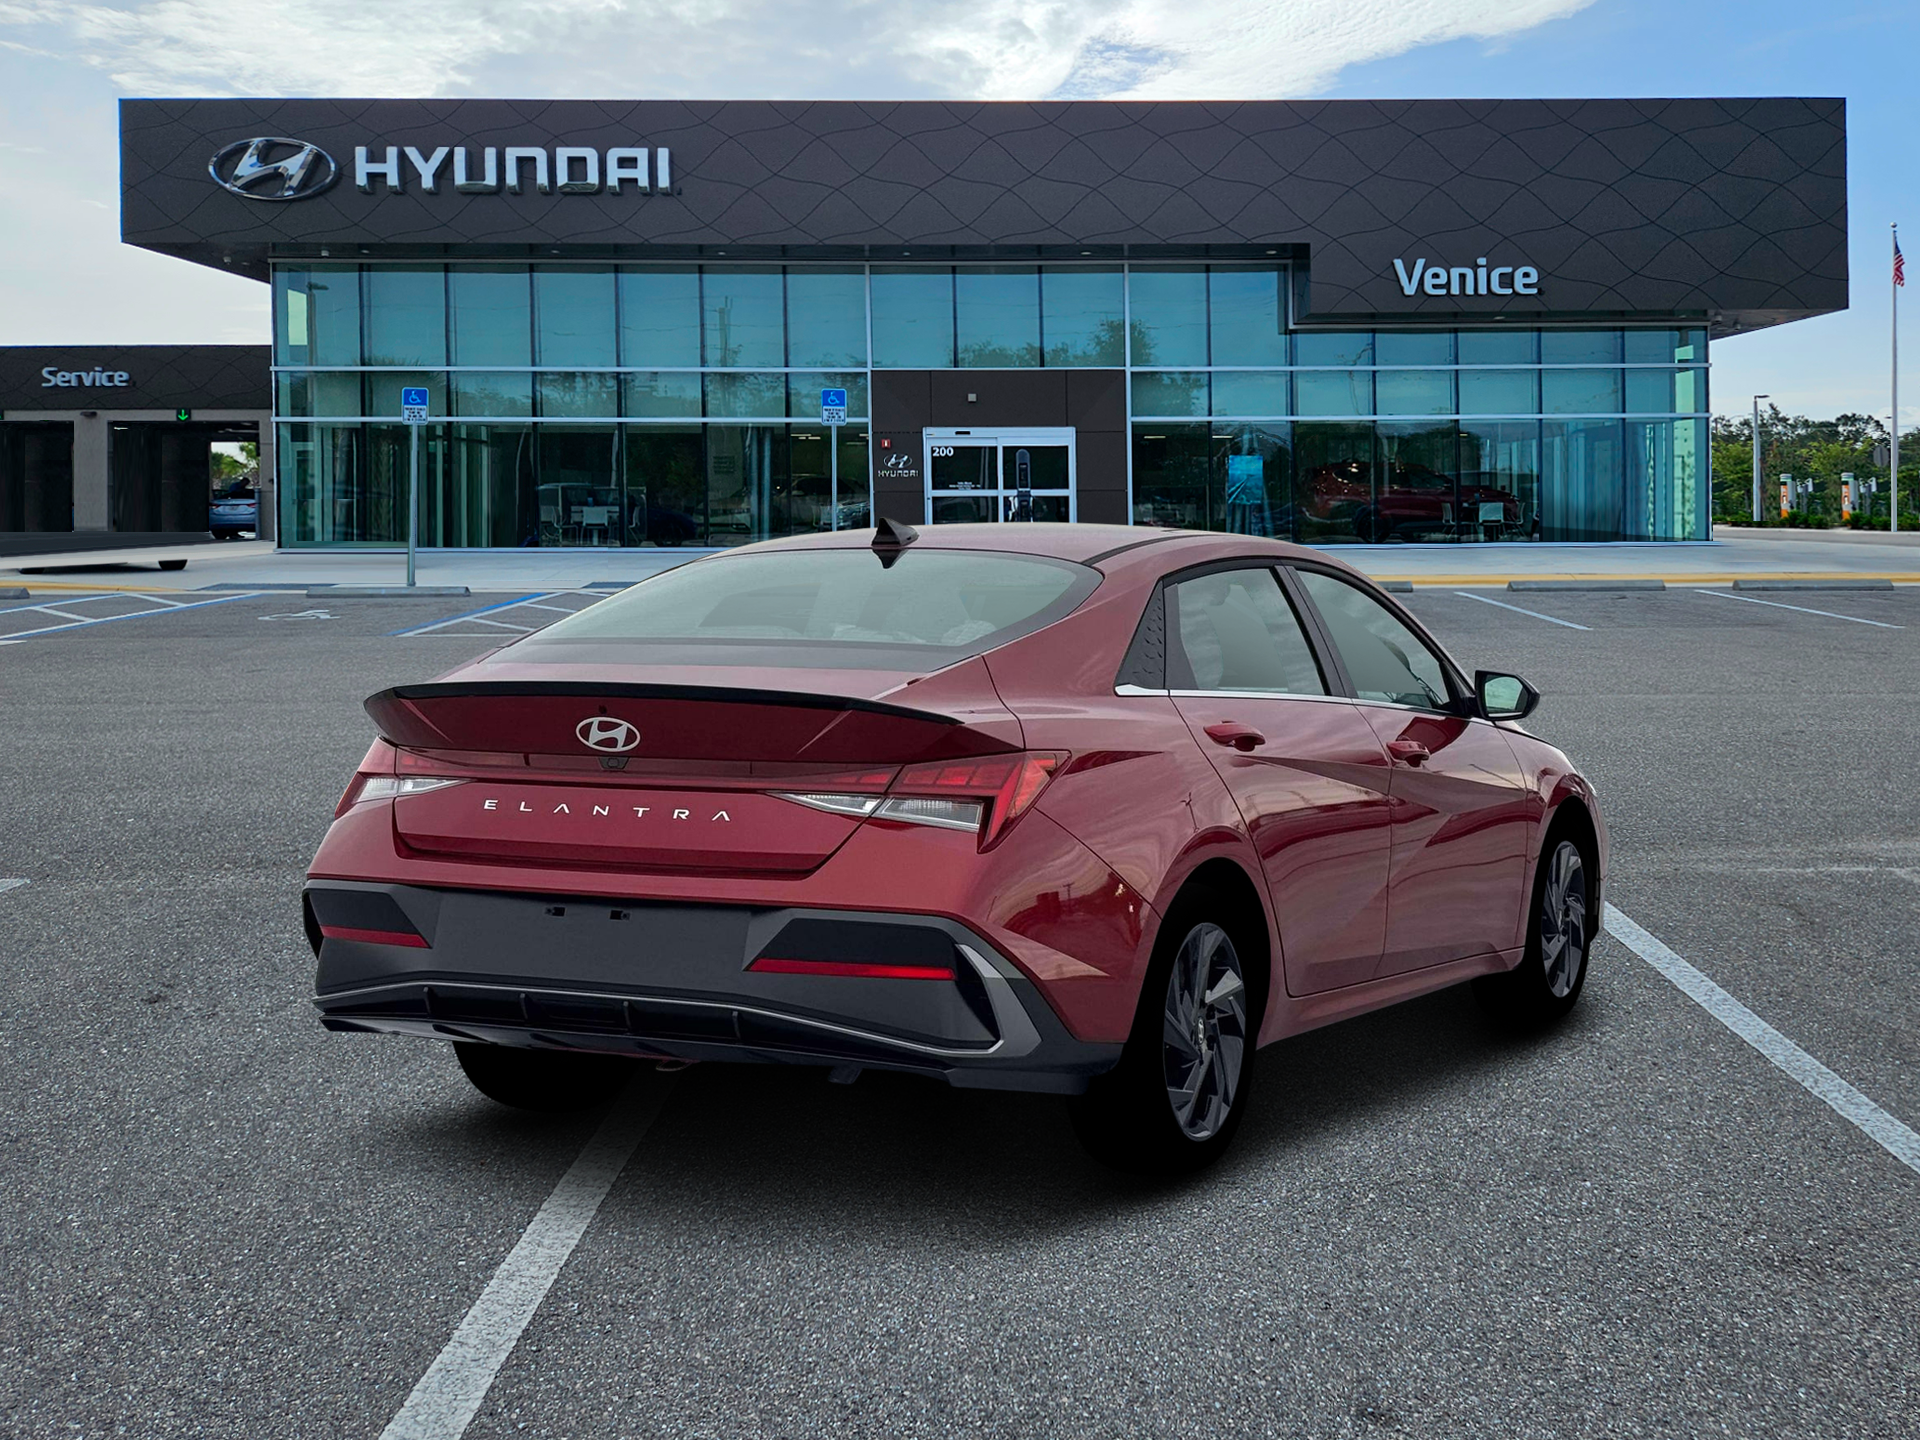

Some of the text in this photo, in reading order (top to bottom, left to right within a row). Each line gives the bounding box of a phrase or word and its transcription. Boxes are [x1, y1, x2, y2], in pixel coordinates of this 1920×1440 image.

[354, 146, 671, 194] HYUNDAI
[1393, 257, 1539, 296] Venice
[41, 367, 130, 387] Service
[932, 447, 954, 457] 200
[877, 470, 919, 478] HYUNDAI
[483, 799, 731, 822] ELANTRA
